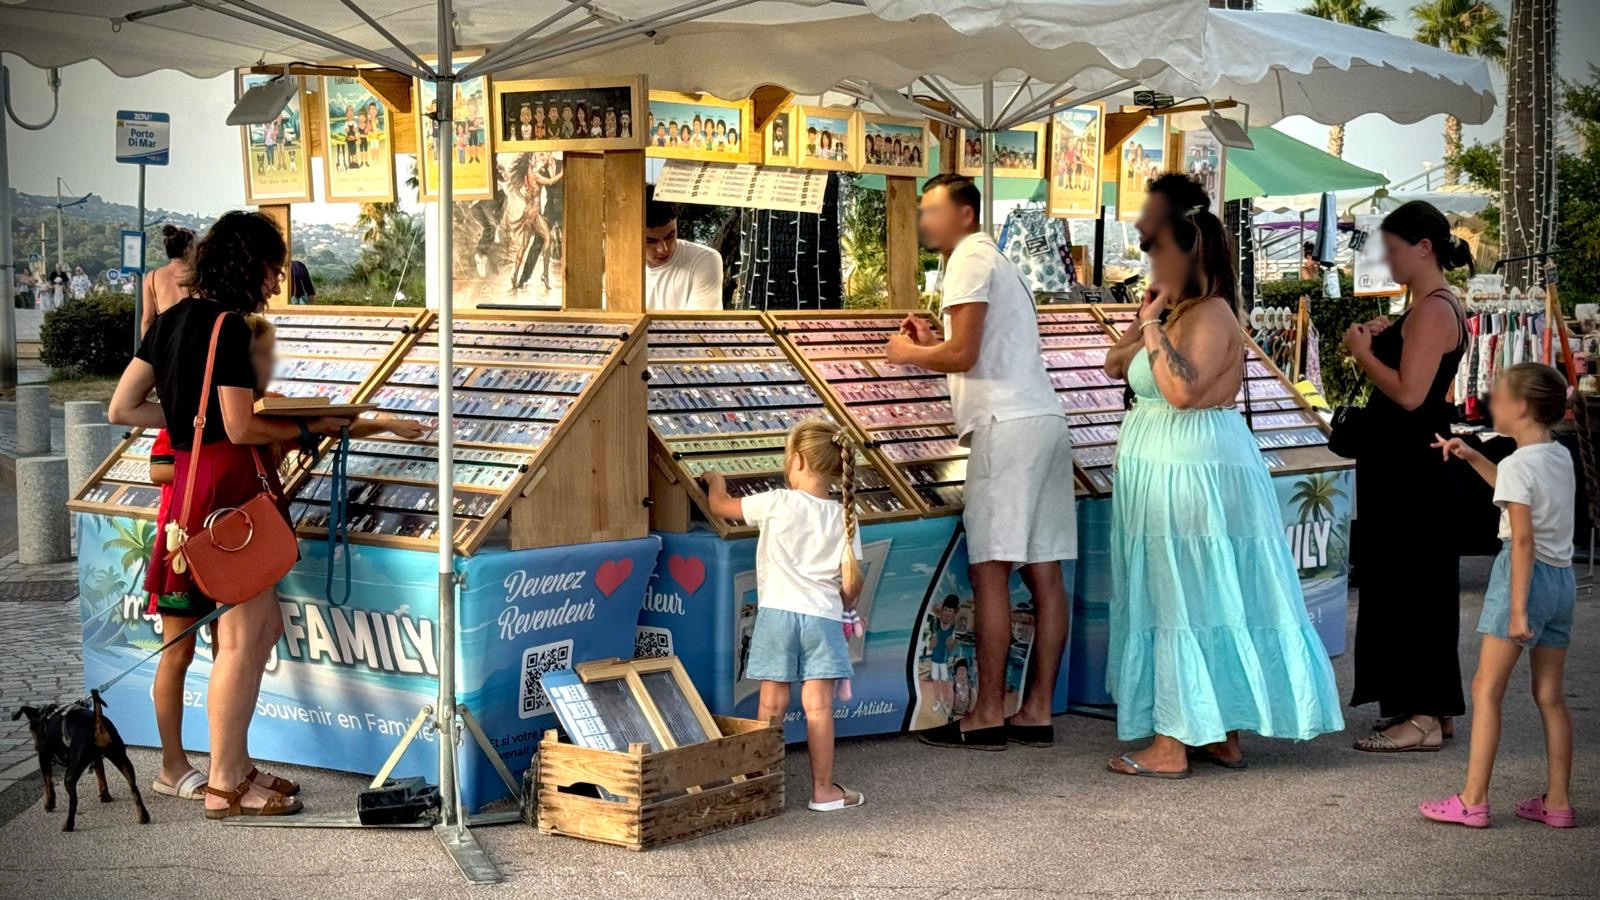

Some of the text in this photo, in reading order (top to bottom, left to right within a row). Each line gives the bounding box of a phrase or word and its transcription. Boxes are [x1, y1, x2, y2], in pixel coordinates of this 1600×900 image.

[128, 138, 157, 148] Di Mar
[130, 128, 155, 139] Porto
[1286, 519, 1331, 569] ILY
[503, 569, 587, 603] Devenez
[498, 597, 596, 640] Revendeur
[280, 602, 438, 676] FAMILY
[256, 696, 333, 727] Souvenir
[337, 711, 362, 731] en
[512, 730, 538, 744] votre
